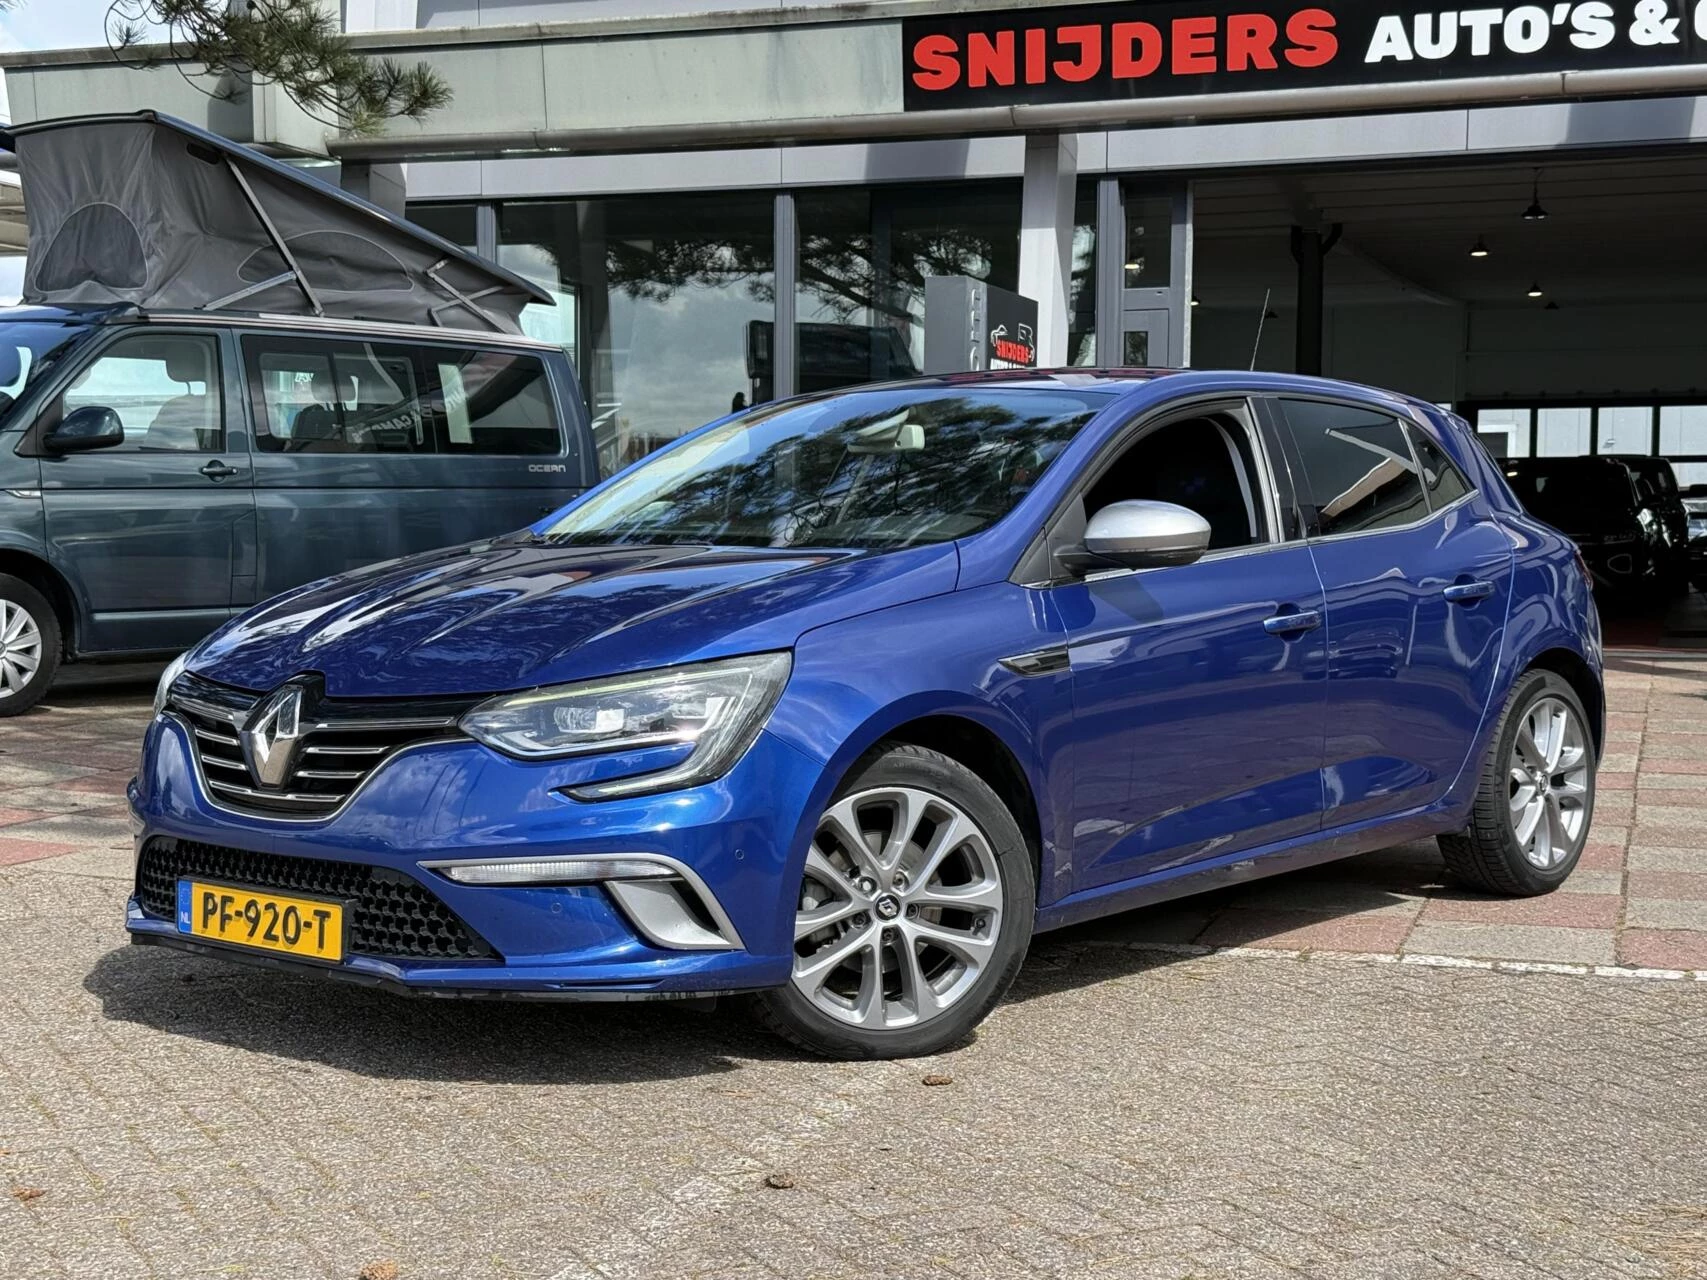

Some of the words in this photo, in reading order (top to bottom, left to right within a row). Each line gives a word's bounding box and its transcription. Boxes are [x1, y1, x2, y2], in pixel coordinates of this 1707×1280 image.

[912, 9, 1338, 90] SNIJDERS
[1364, 1, 1616, 63] AUTO'S
[1629, 0, 1680, 46] &
[528, 464, 566, 473] OCEAN
[180, 911, 191, 924] NL
[203, 891, 331, 950] PF-920-T
